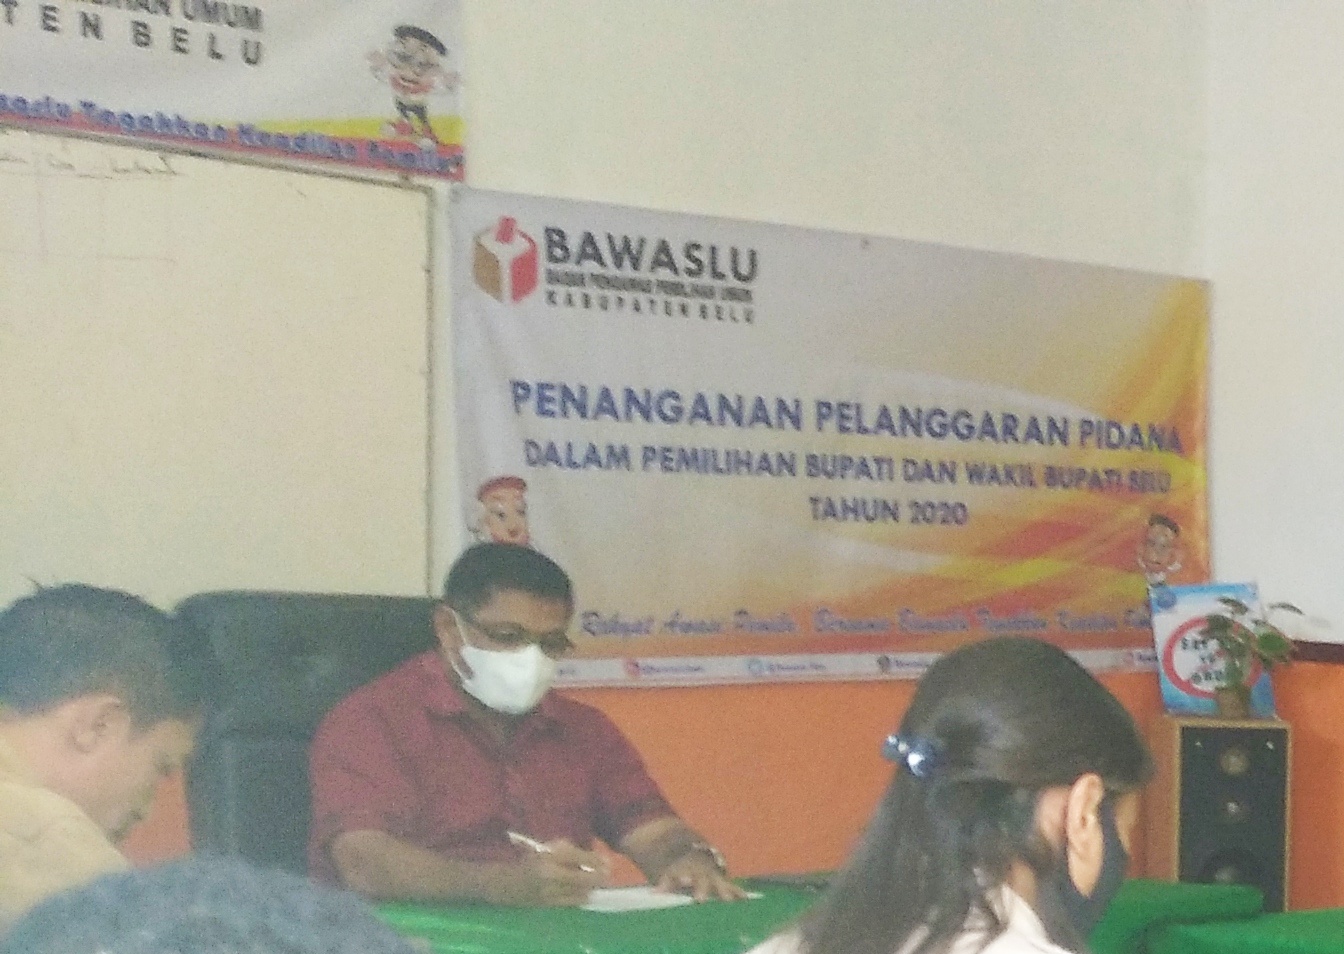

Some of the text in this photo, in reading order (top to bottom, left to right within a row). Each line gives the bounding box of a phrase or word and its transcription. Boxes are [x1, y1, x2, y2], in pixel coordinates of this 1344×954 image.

[131, 20, 262, 65] BELU
[544, 226, 758, 283] BAWASLU
[510, 379, 1185, 455] PENANGANAN PELANGGARAN PIDANA
[523, 438, 636, 471] DALAM
[641, 445, 797, 477] PEMILIHAN
[804, 453, 894, 482] BUPATI
[902, 457, 957, 484] DAN
[965, 462, 1038, 489] WAKIL
[1044, 465, 1122, 490] BUPATI
[809, 496, 968, 526] TAHUN 2020
